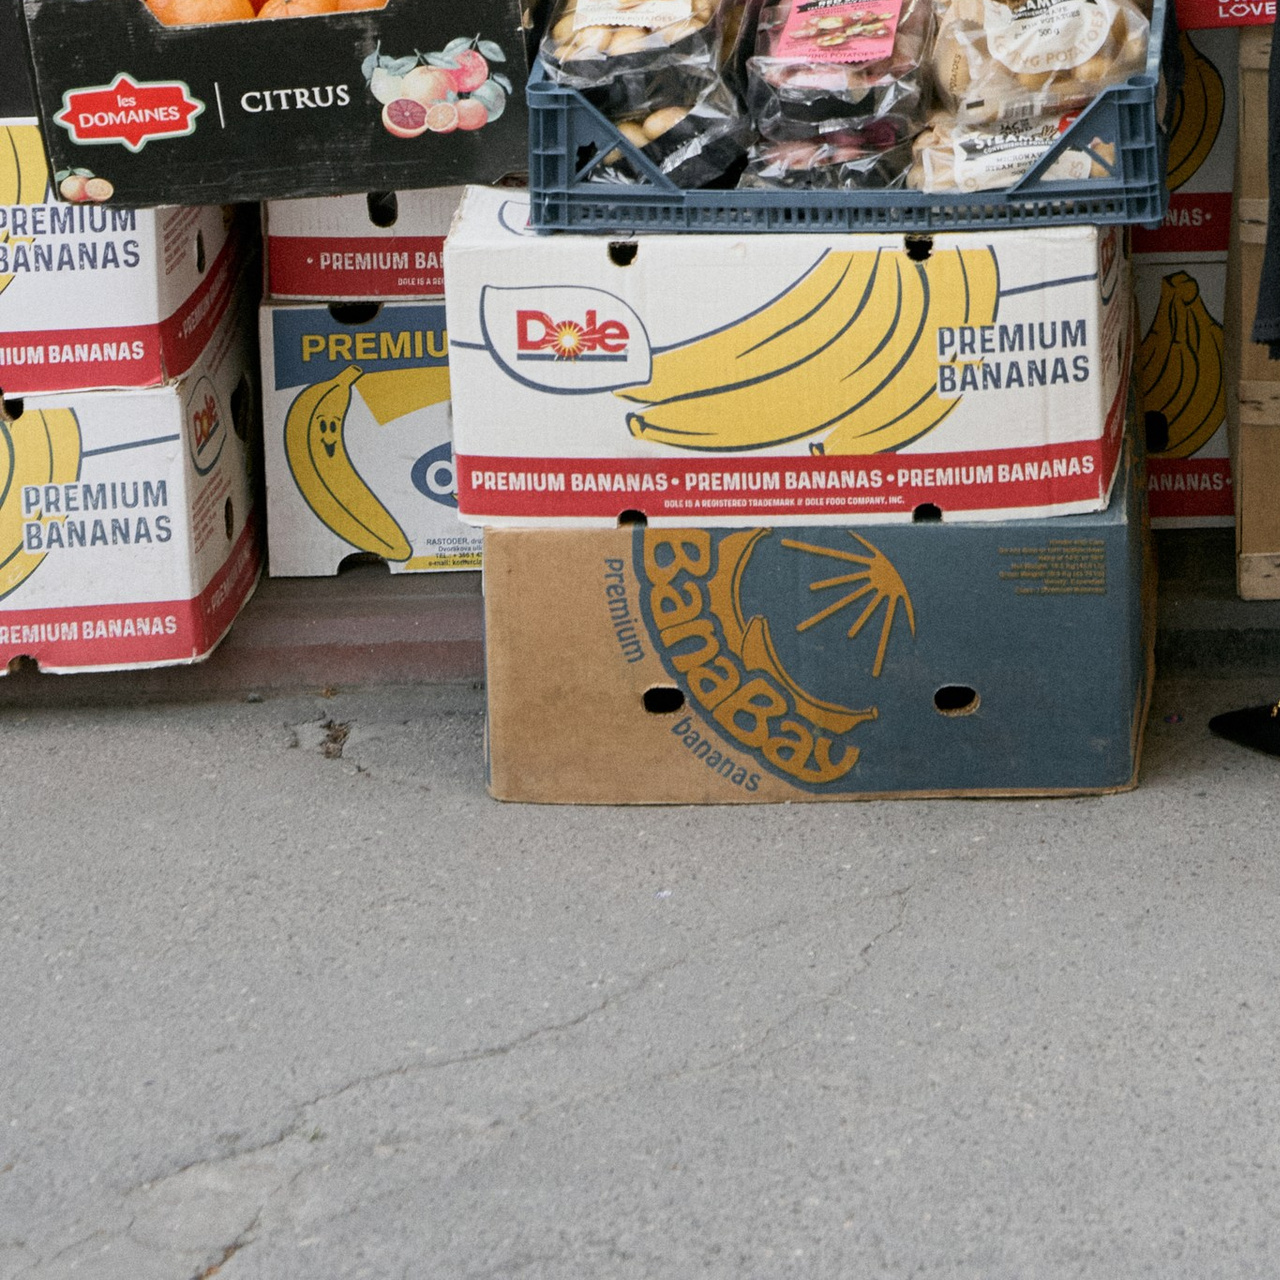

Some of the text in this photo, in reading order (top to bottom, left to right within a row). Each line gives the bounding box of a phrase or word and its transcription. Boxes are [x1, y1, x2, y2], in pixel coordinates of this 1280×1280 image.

[116, 93, 137, 109] les
[239, 83, 351, 113] CITRUS
[78, 103, 181, 129] DOMAINES
[320, 251, 409, 271] PREMIUM
[302, 328, 449, 362] PREMIU
[515, 309, 631, 357] Dole
[938, 319, 1088, 358] PREMIUM
[48, 341, 145, 364] BANANAS
[938, 355, 1091, 393] BANANAS
[471, 455, 1095, 493] PREMIUM BANANAS PREMIUM BANANAS PREMIUM BANANAS
[1147, 471, 1224, 492] ANANAS
[24, 479, 169, 513] PREMIUM
[748, 498, 796, 508] TRADEMARK
[24, 515, 173, 550] BANANAS
[605, 557, 645, 666] premium
[0, 616, 177, 644] REMIUM BANANAS
[644, 528, 859, 784] BanaBay
[671, 714, 761, 794] bananas
